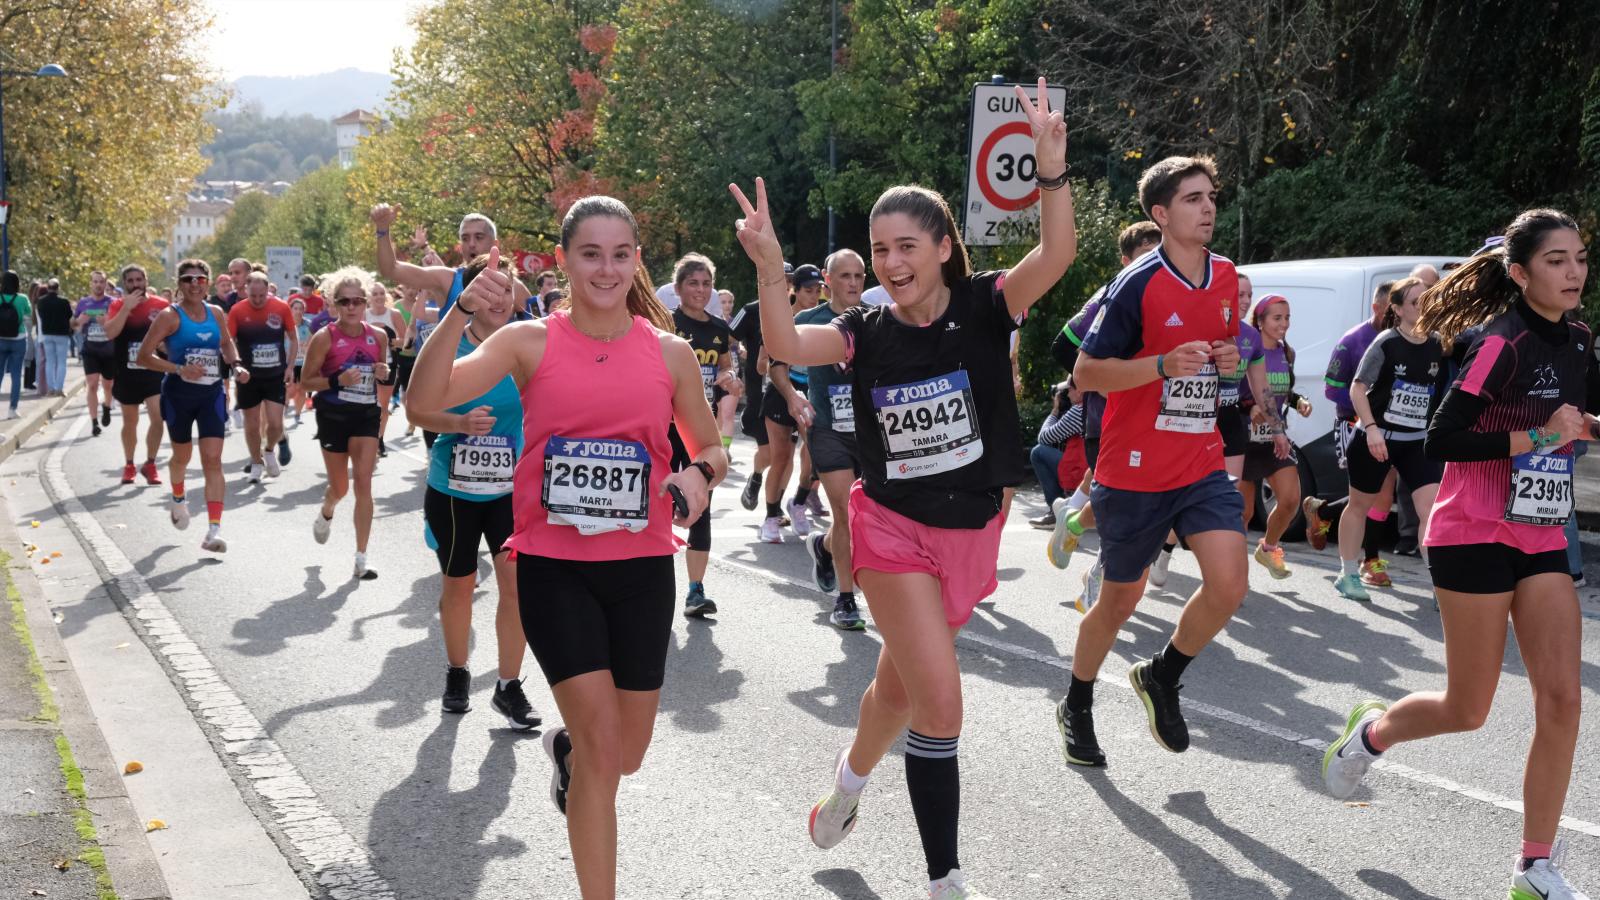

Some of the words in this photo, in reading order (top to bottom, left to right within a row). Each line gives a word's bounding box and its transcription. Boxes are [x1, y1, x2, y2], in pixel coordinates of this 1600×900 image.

[995, 153, 1037, 182] 30
[901, 378, 952, 403] Joma
[1171, 380, 1217, 400] 26322
[835, 397, 853, 410] 22
[1395, 392, 1429, 409] 18555
[885, 397, 967, 436] 24942
[474, 435, 508, 447] Joma
[580, 441, 637, 458] Joma
[912, 432, 949, 447] TAMARA
[458, 448, 511, 468] 19933
[552, 462, 641, 493] 26887
[1517, 476, 1570, 502] 23997
[579, 495, 613, 506] MARTA
